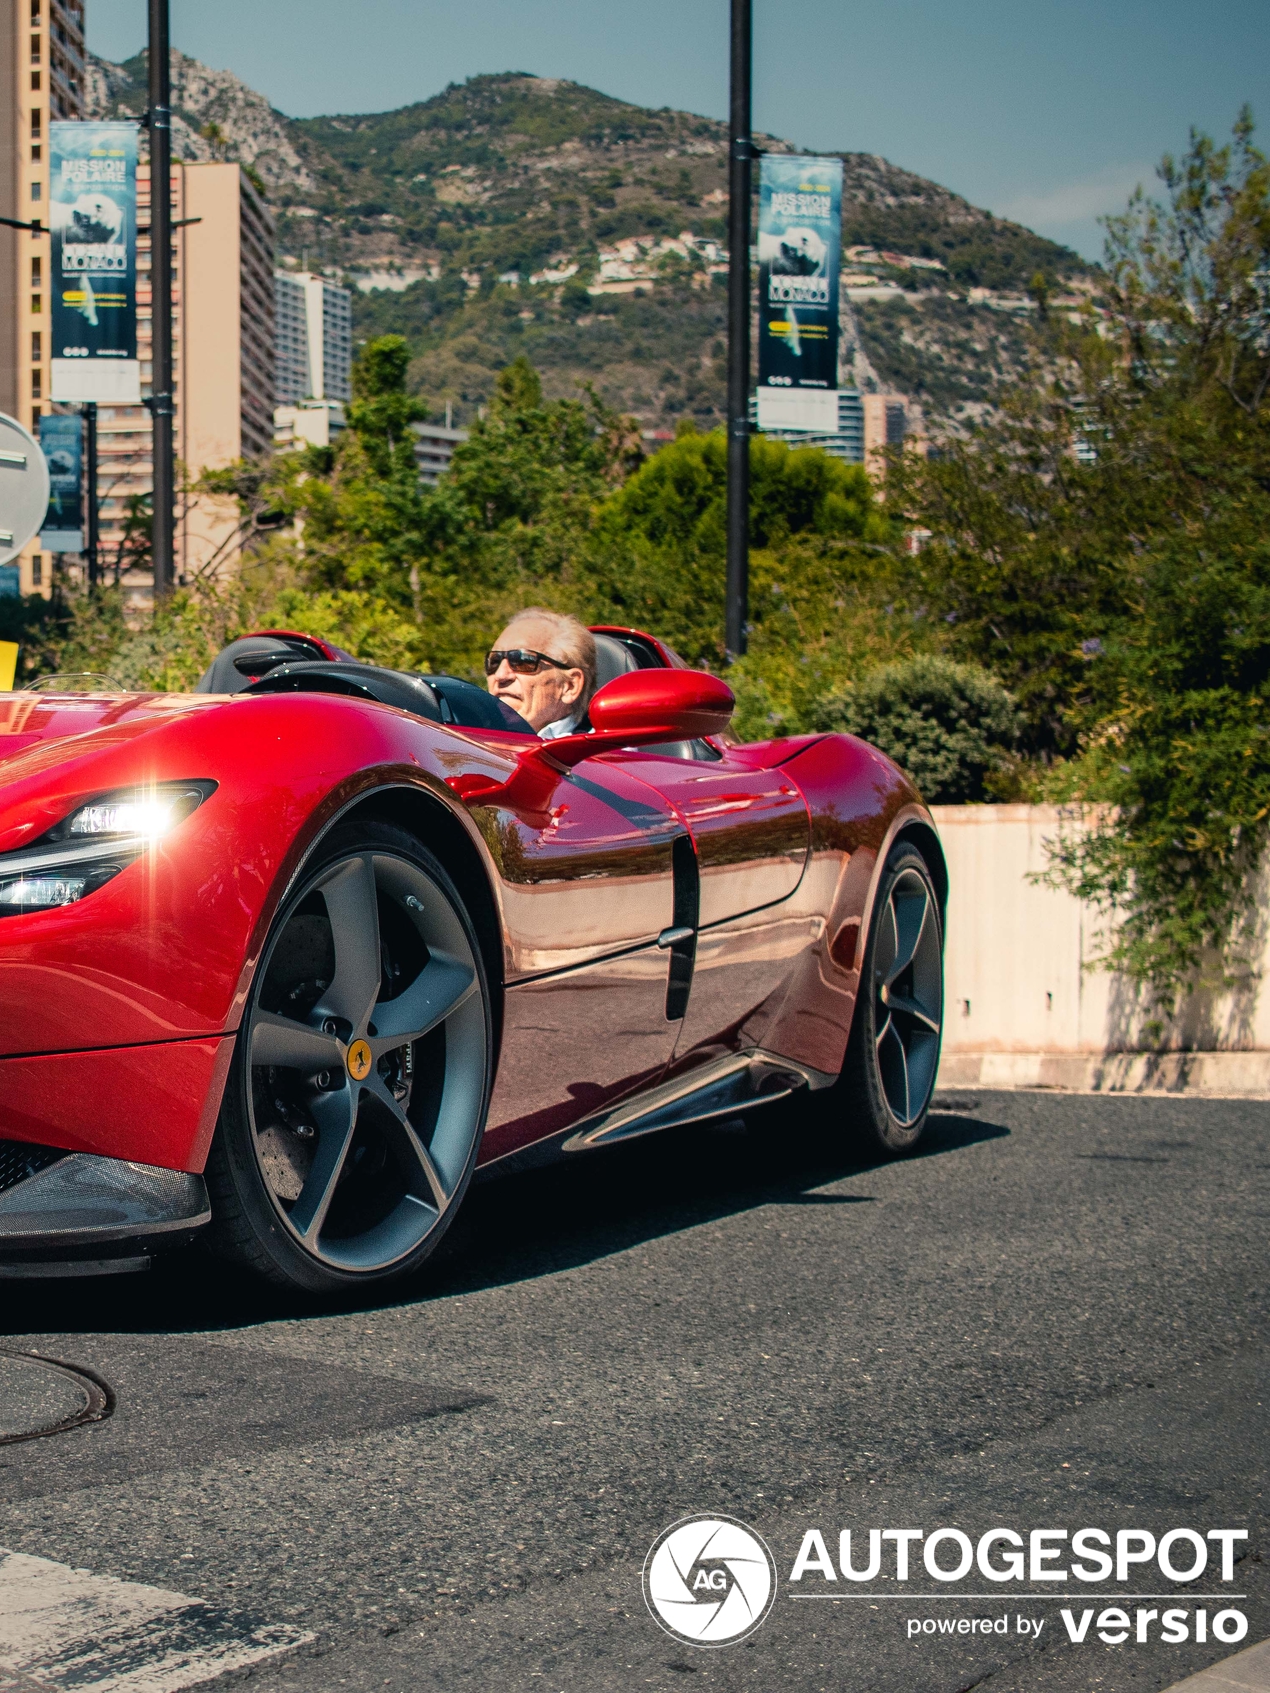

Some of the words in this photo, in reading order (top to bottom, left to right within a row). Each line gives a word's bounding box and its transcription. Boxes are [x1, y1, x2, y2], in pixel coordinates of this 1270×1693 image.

[61, 159, 127, 172] MISSION
[61, 171, 127, 183] POLAIRE
[771, 193, 832, 208] MISSION
[771, 203, 832, 218] POLAIRE
[62, 255, 127, 270] MONACO
[770, 286, 829, 302] MONACO
